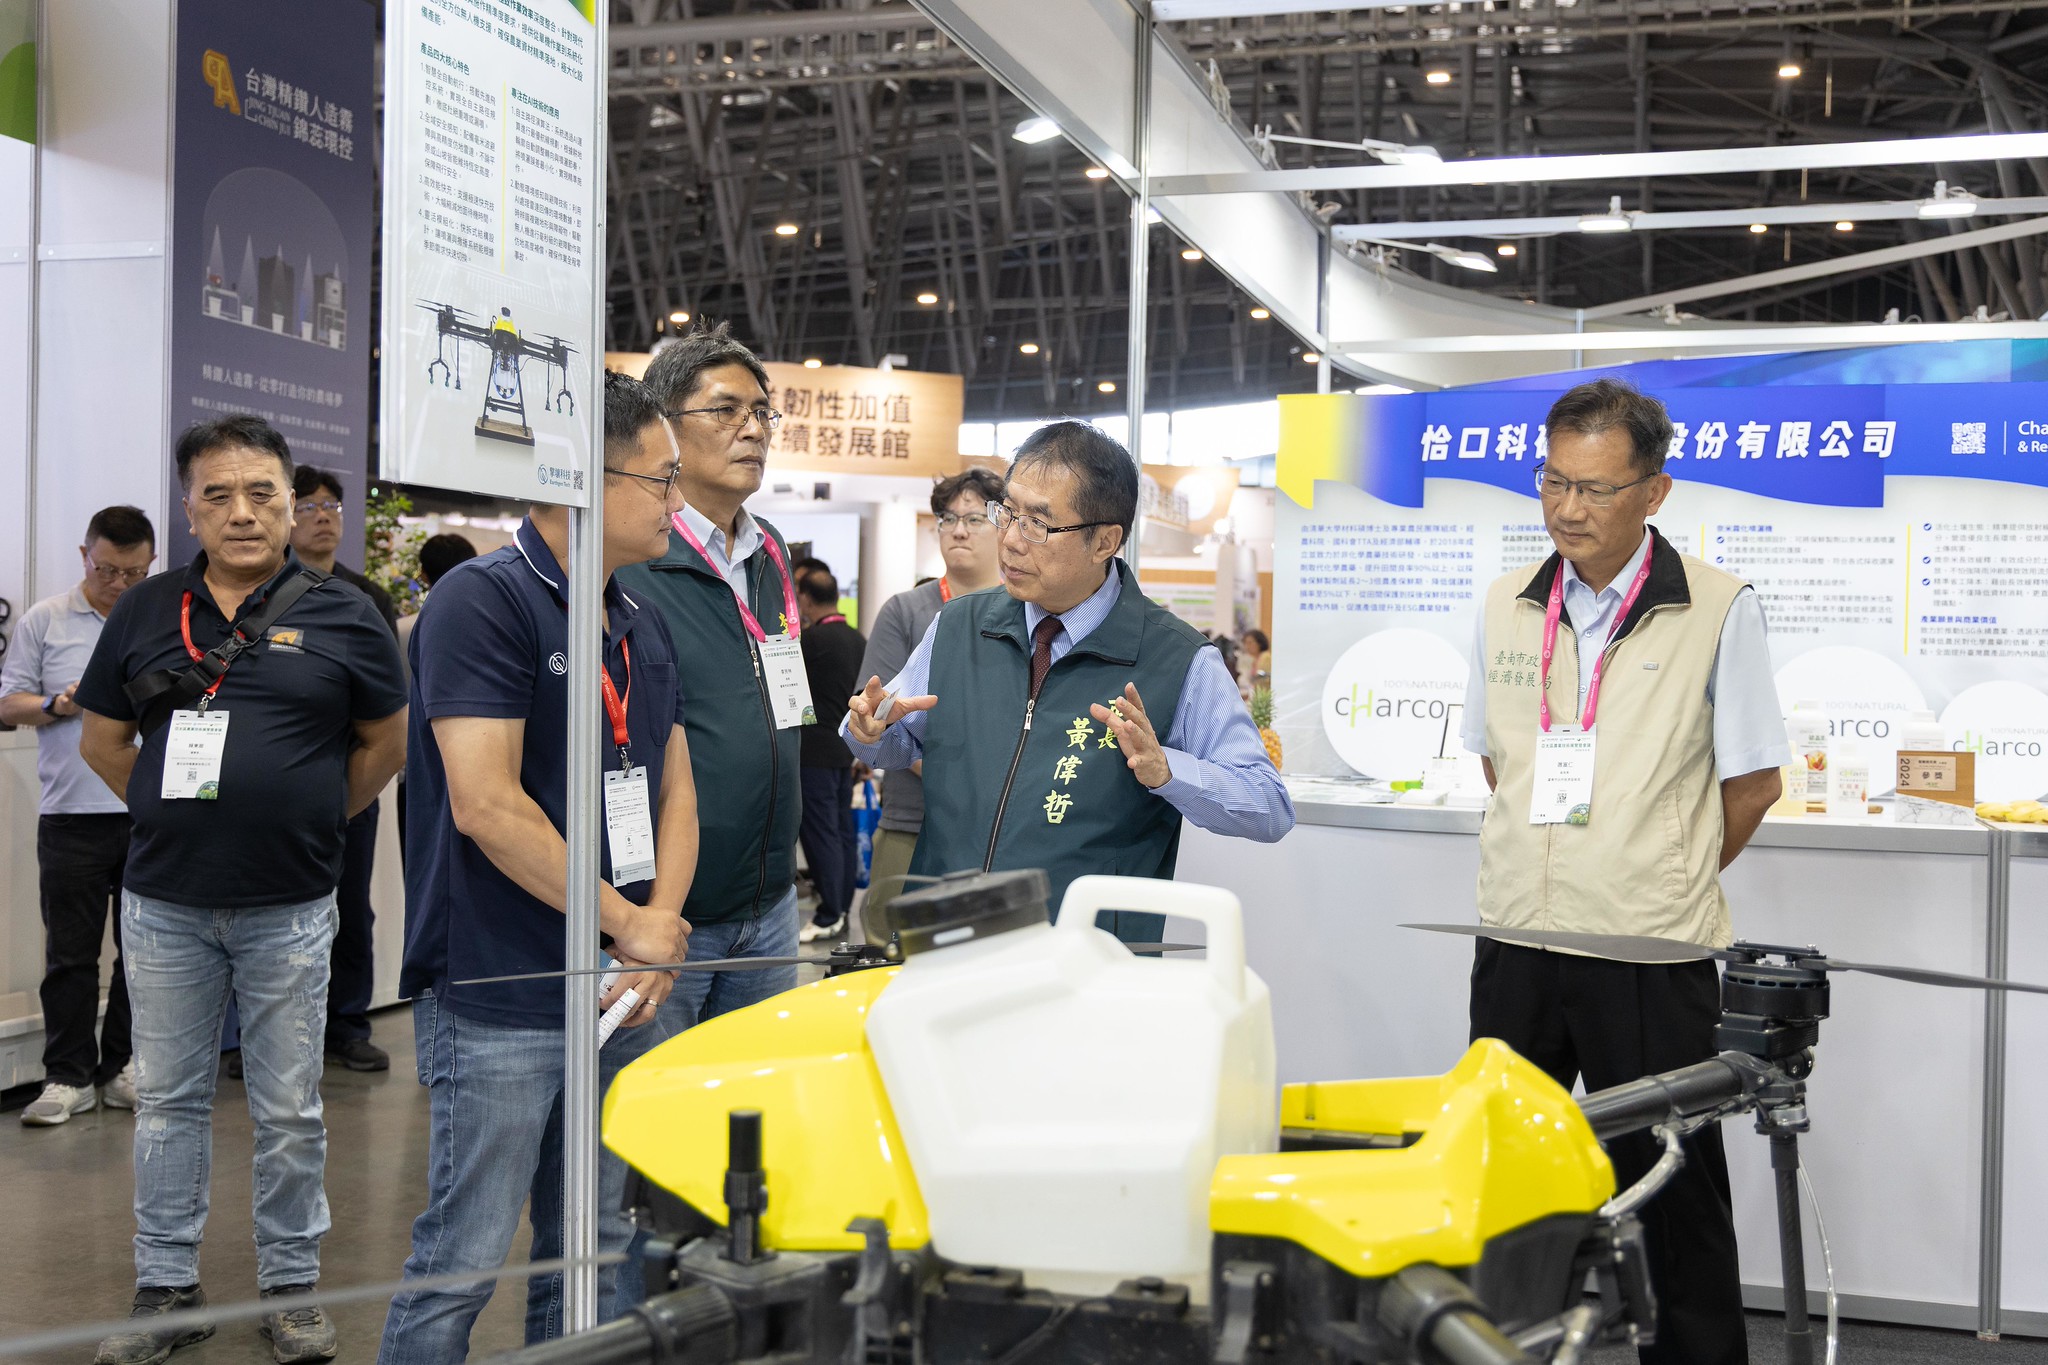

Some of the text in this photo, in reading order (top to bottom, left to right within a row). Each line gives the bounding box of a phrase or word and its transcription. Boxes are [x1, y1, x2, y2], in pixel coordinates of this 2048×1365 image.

[420, 42, 469, 76] 產品四大核心特色
[511, 86, 559, 119] 專注在AI技術的應用
[424, 156, 461, 181] 保障飛行安全。
[515, 162, 523, 175] 作。
[514, 248, 527, 263] 事故。
[768, 387, 912, 424] 韌性加值
[769, 424, 911, 459] 續發展館
[2018, 420, 2048, 435] Cha
[2017, 441, 2048, 453] & Re
[1043, 717, 1095, 824] 黃偉哲
[1900, 758, 1911, 787] 2024
